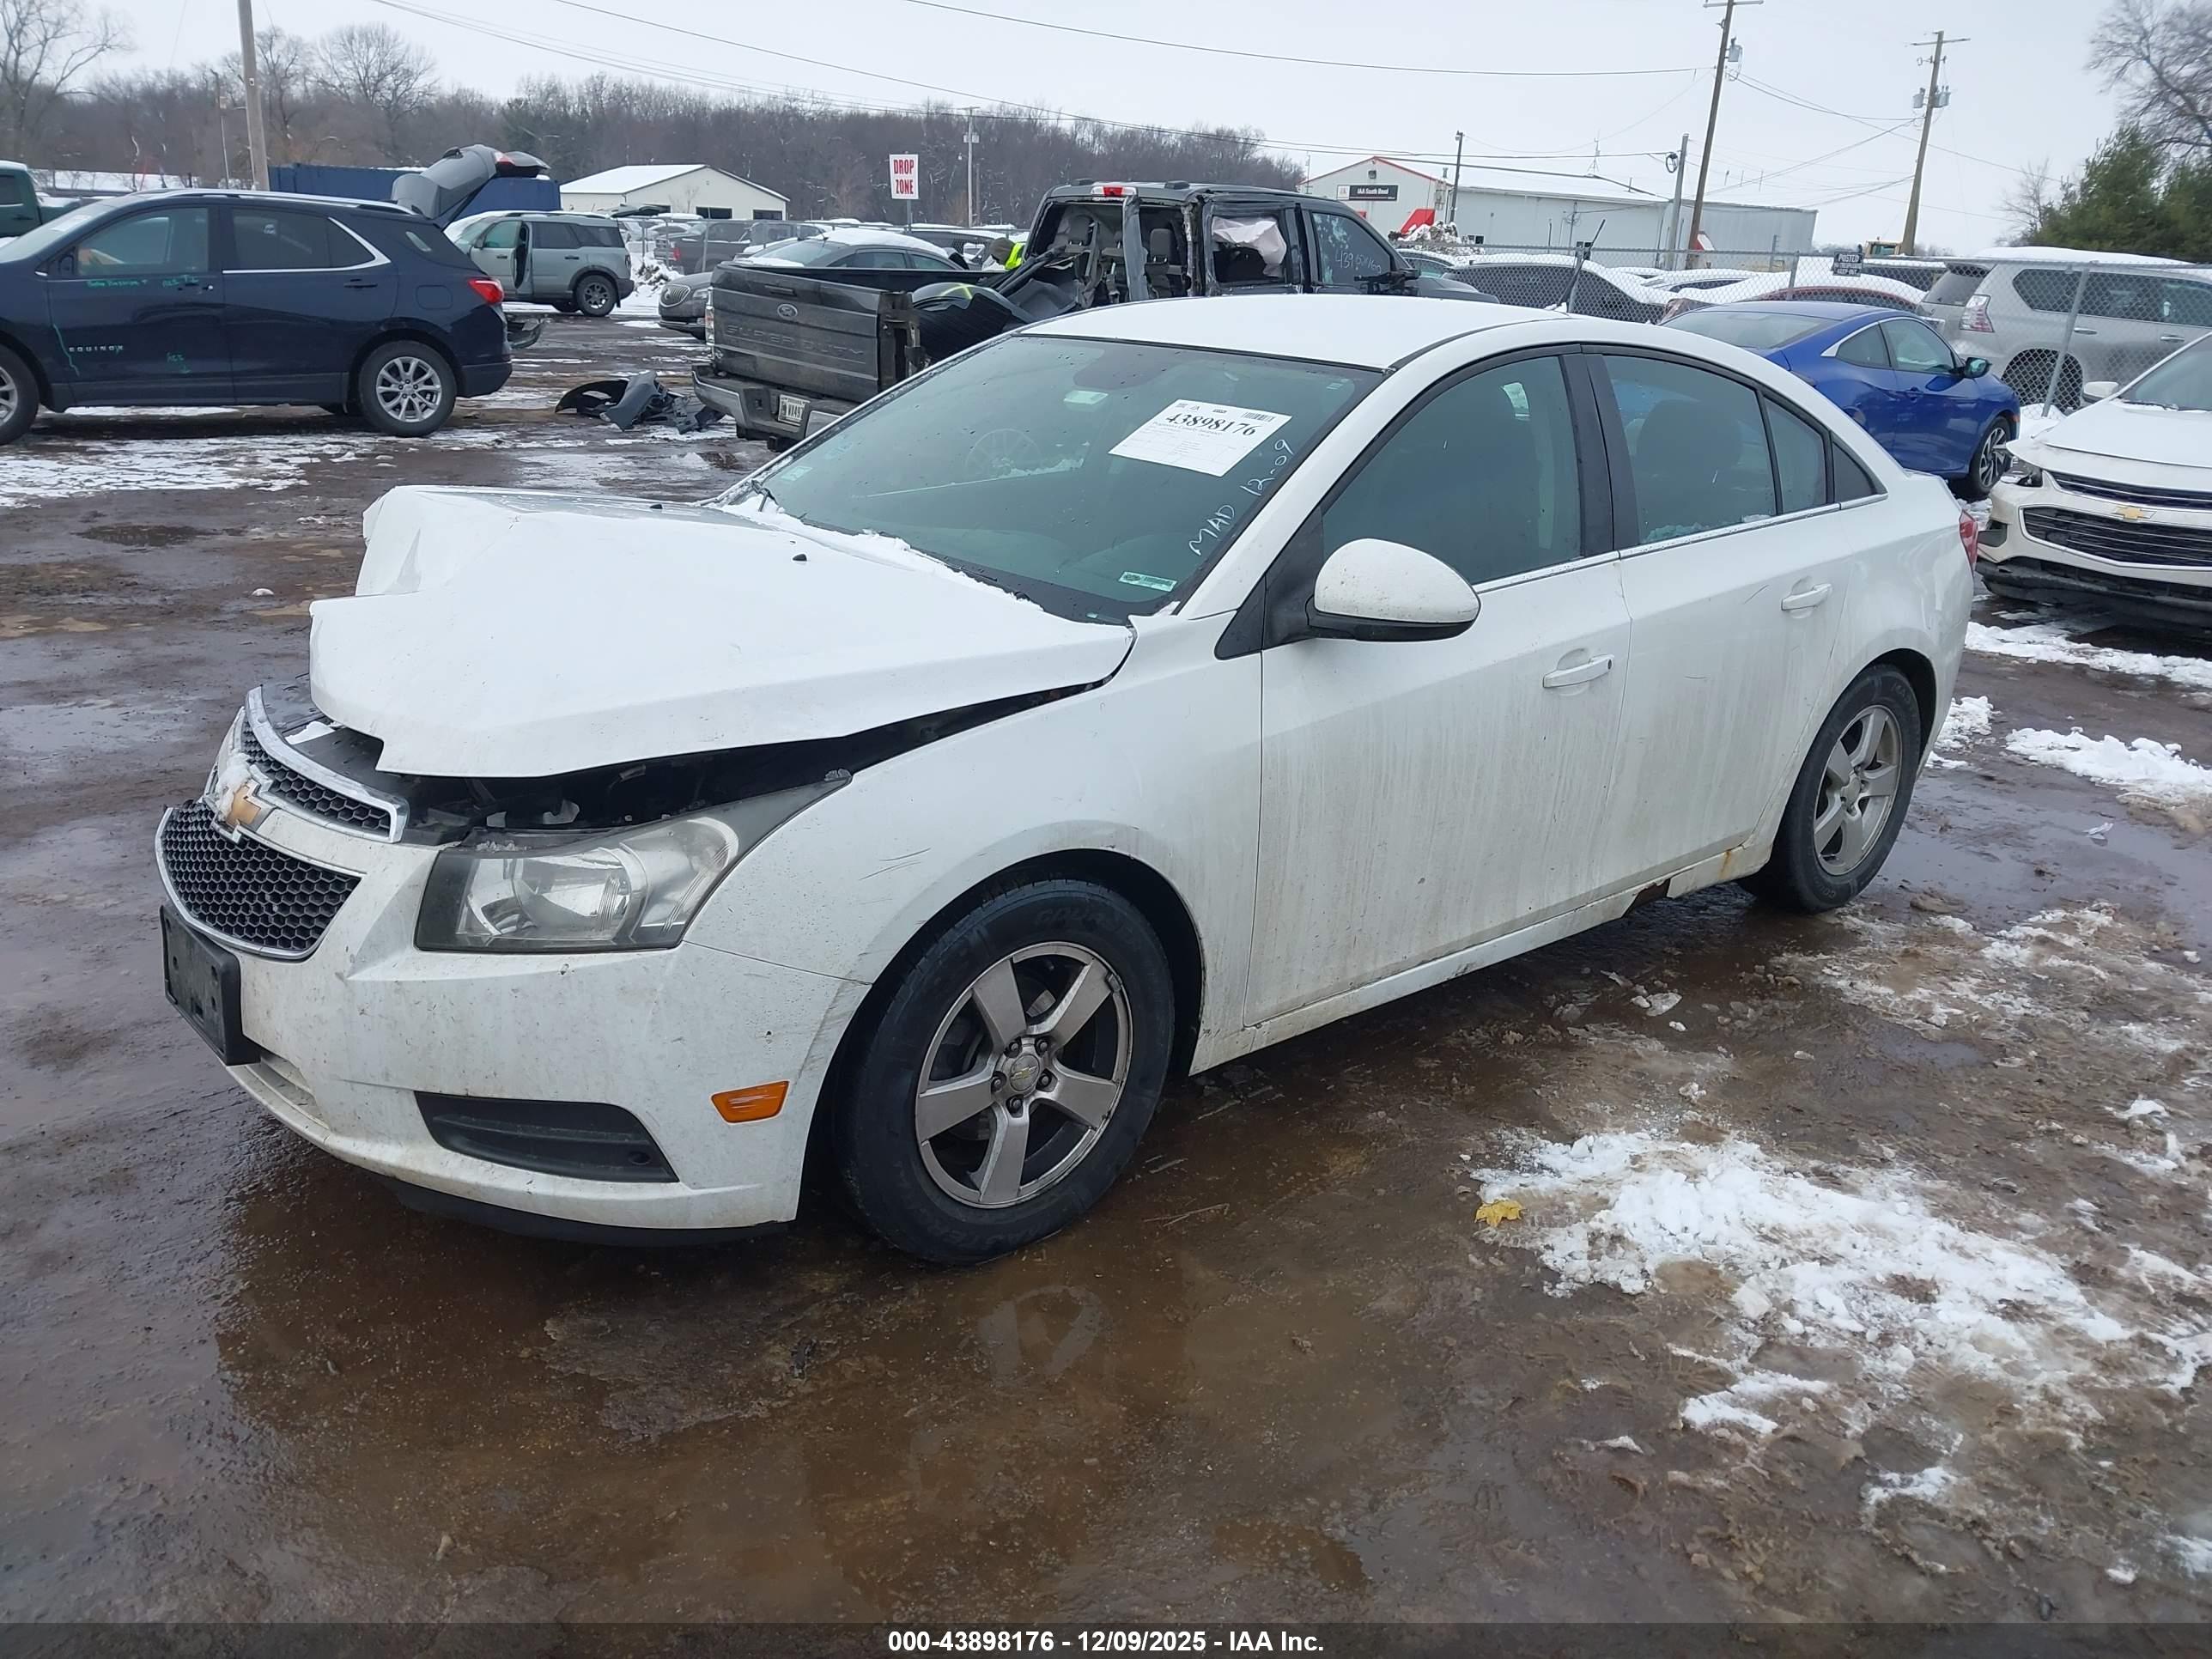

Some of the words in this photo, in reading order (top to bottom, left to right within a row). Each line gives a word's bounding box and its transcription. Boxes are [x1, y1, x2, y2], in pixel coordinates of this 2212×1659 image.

[893, 159, 915, 174] DROP
[895, 179, 914, 194] ZONE
[1838, 253, 1860, 263] POSTED
[727, 325, 796, 344] SUPER
[804, 339, 864, 356] DUTY
[1165, 413, 1263, 436] 43898176
[1188, 504, 1235, 556] MAD
[1239, 439, 1294, 496] 12-09
